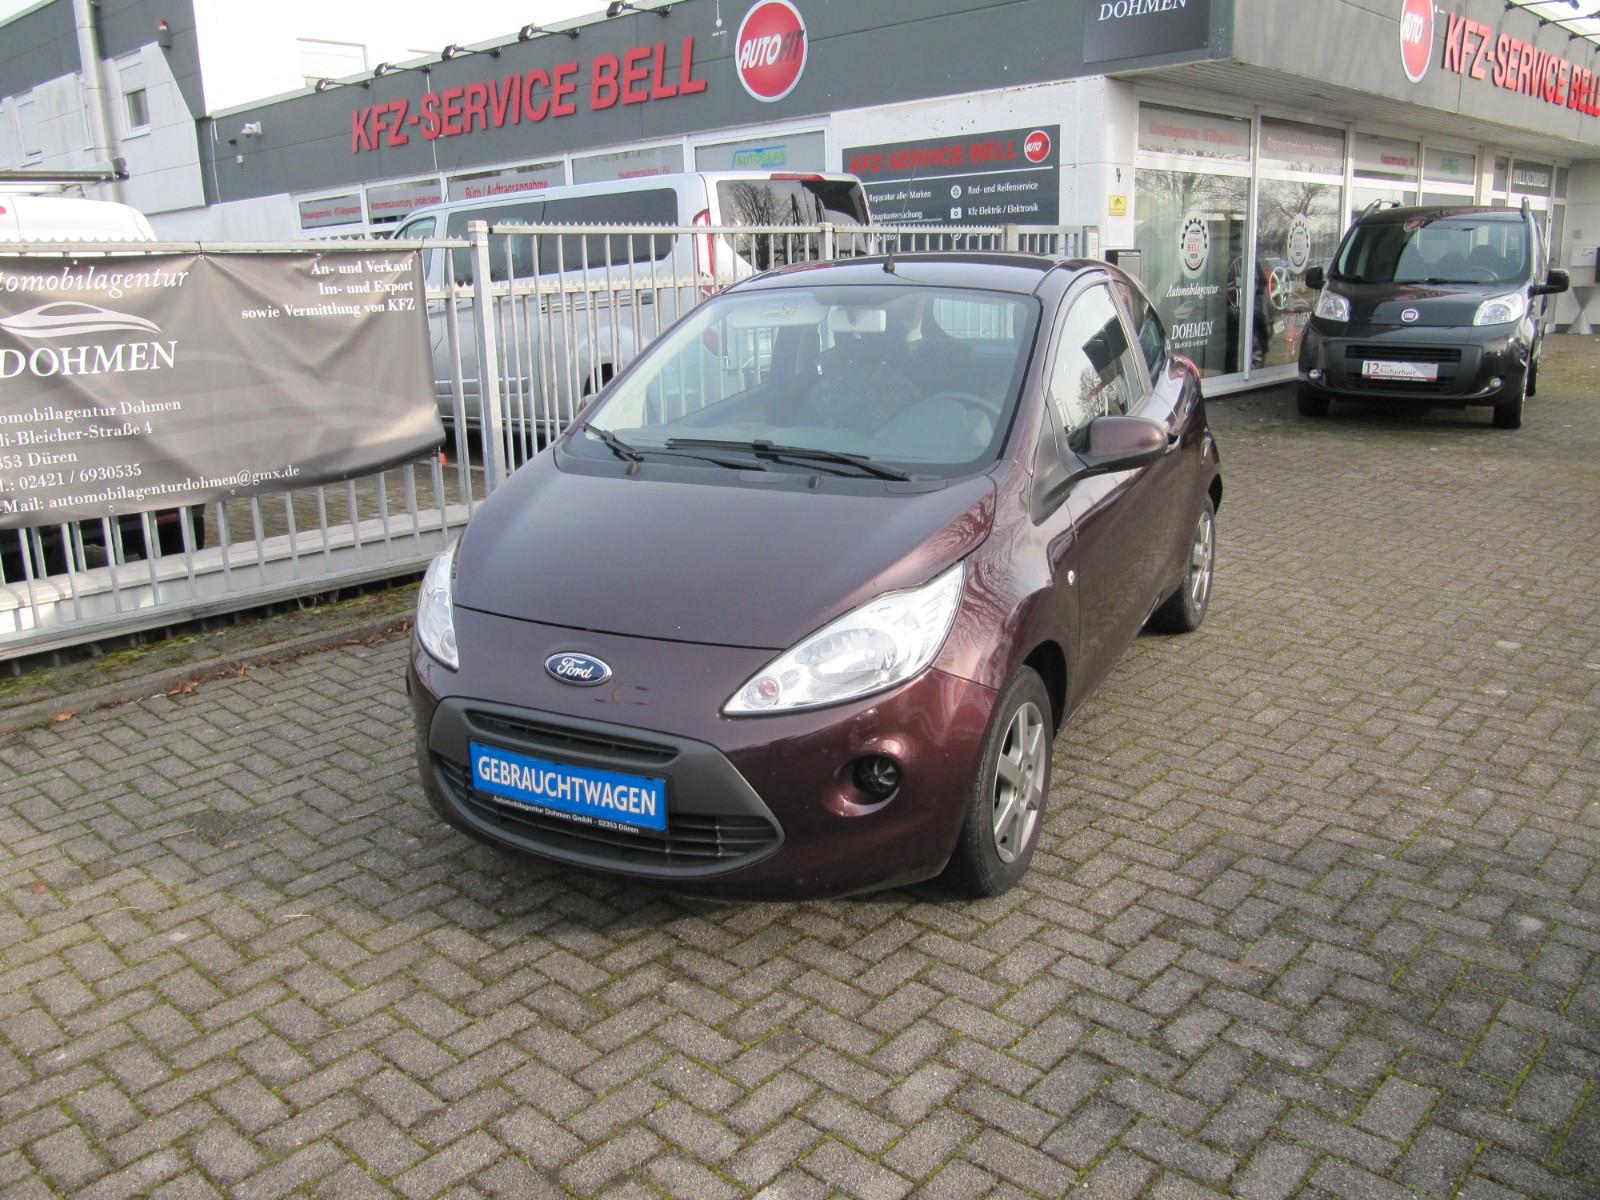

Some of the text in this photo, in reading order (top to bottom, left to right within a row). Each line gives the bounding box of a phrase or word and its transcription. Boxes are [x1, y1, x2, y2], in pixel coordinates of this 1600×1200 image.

[1441, 11, 1569, 106] KFZ-SERVICE
[351, 36, 707, 153] KFZ-SERVICE BELL
[850, 140, 1017, 175] KFZ-SERVICE BELL
[909, 190, 932, 199] Marken
[968, 181, 1039, 195] Rad- und Reifenservice
[968, 206, 978, 216] Kfz
[979, 204, 1002, 215] Elektrik
[1007, 202, 1039, 214] Elektronik
[310, 259, 413, 275] An- und Verkauf
[318, 280, 414, 296] Im- und Export
[241, 298, 416, 320] sowie Vermittlung von KFZ
[1171, 320, 1214, 340] DOHMEN
[0, 340, 178, 379] DOHMEN
[1365, 363, 1380, 375] 12
[120, 400, 182, 415] Dohmen
[144, 422, 153, 434] 4
[28, 452, 79, 467] Düren
[19, 472, 65, 490] 02421
[79, 464, 142, 483] 6930535
[49, 465, 300, 509] automobilagenturdohmen@gmx.de
[557, 656, 592, 680] Ford
[478, 755, 656, 816] GEBRAUCHTWAGEN
[493, 795, 544, 814] Automobilagentur
[545, 807, 571, 820] Dohmen
[572, 813, 593, 825] GmbH
[597, 819, 617, 830] 52353
[618, 823, 640, 834] Düren
